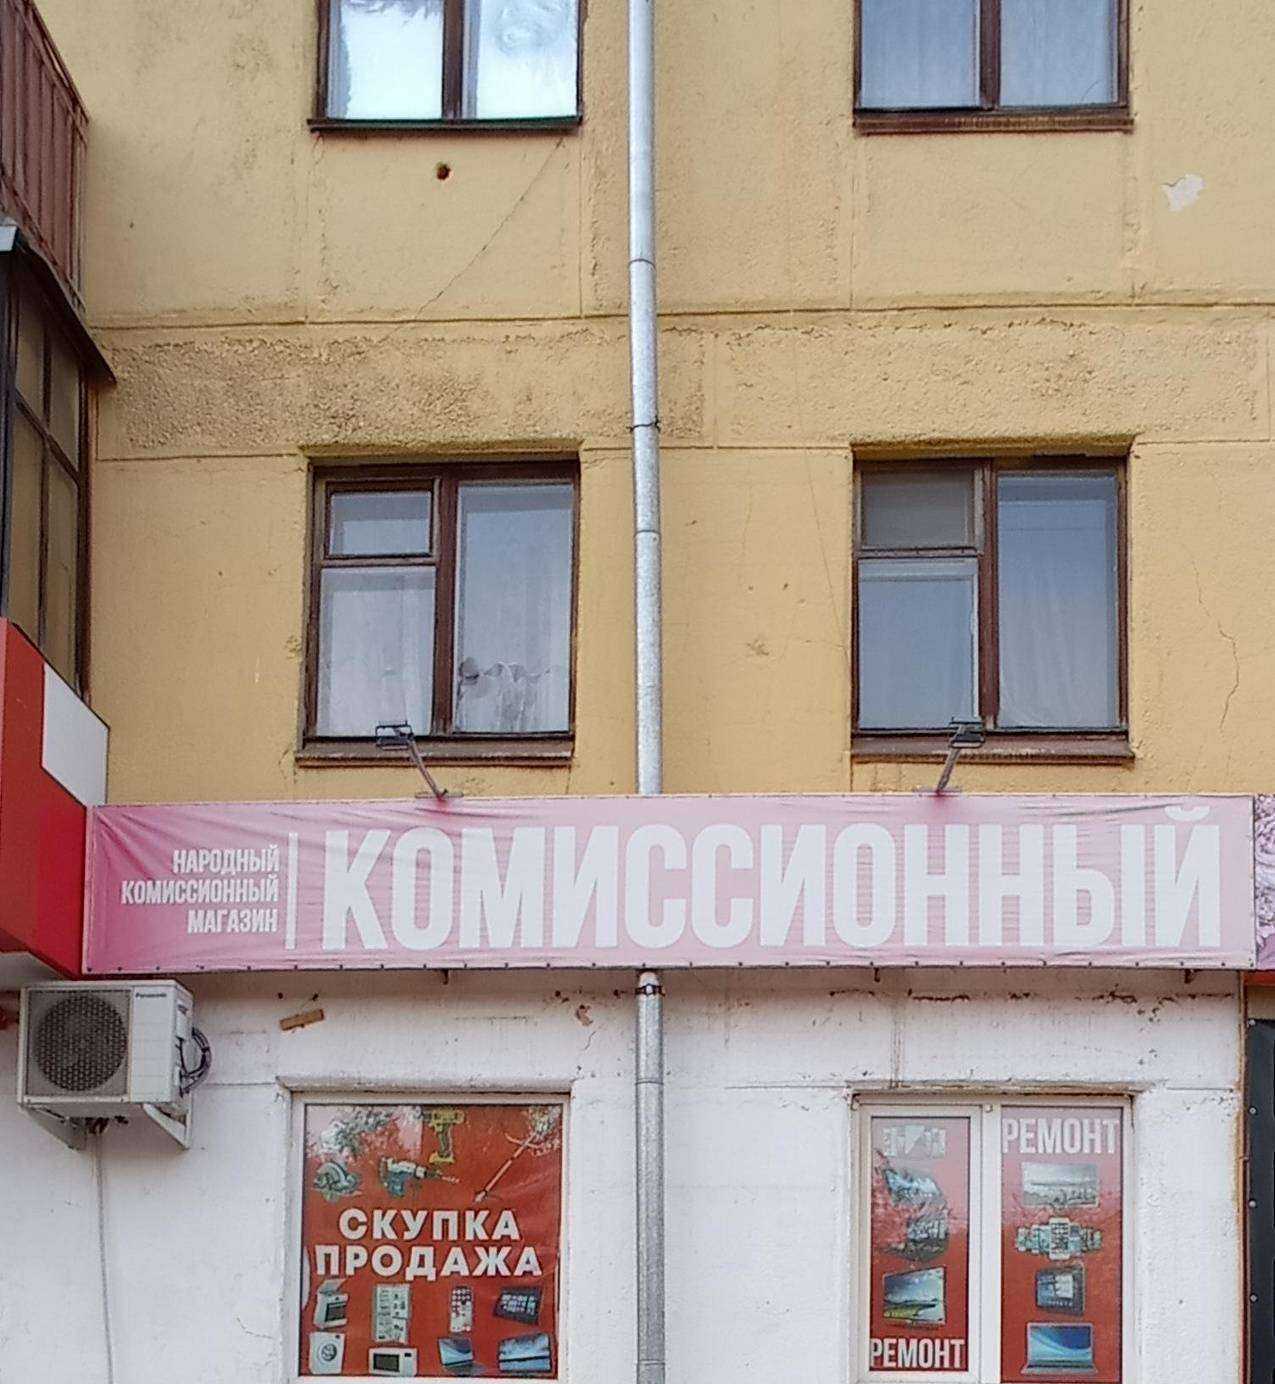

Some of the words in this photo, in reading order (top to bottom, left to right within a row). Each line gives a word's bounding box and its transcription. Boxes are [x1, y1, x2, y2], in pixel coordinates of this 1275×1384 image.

[172, 844, 281, 873] НАРОДНЫЙ
[121, 874, 279, 904] КОМИССИОННЫЙ
[324, 805, 1222, 950] КОМИССИОННЫЙ
[187, 908, 278, 934] МАГАЗИН
[1002, 1118, 1120, 1154] РЕМОНТ
[338, 1208, 521, 1241] СКУПКА
[315, 1245, 543, 1281] ПРОДАЖА
[870, 1338, 966, 1370] РЕМОНТ
